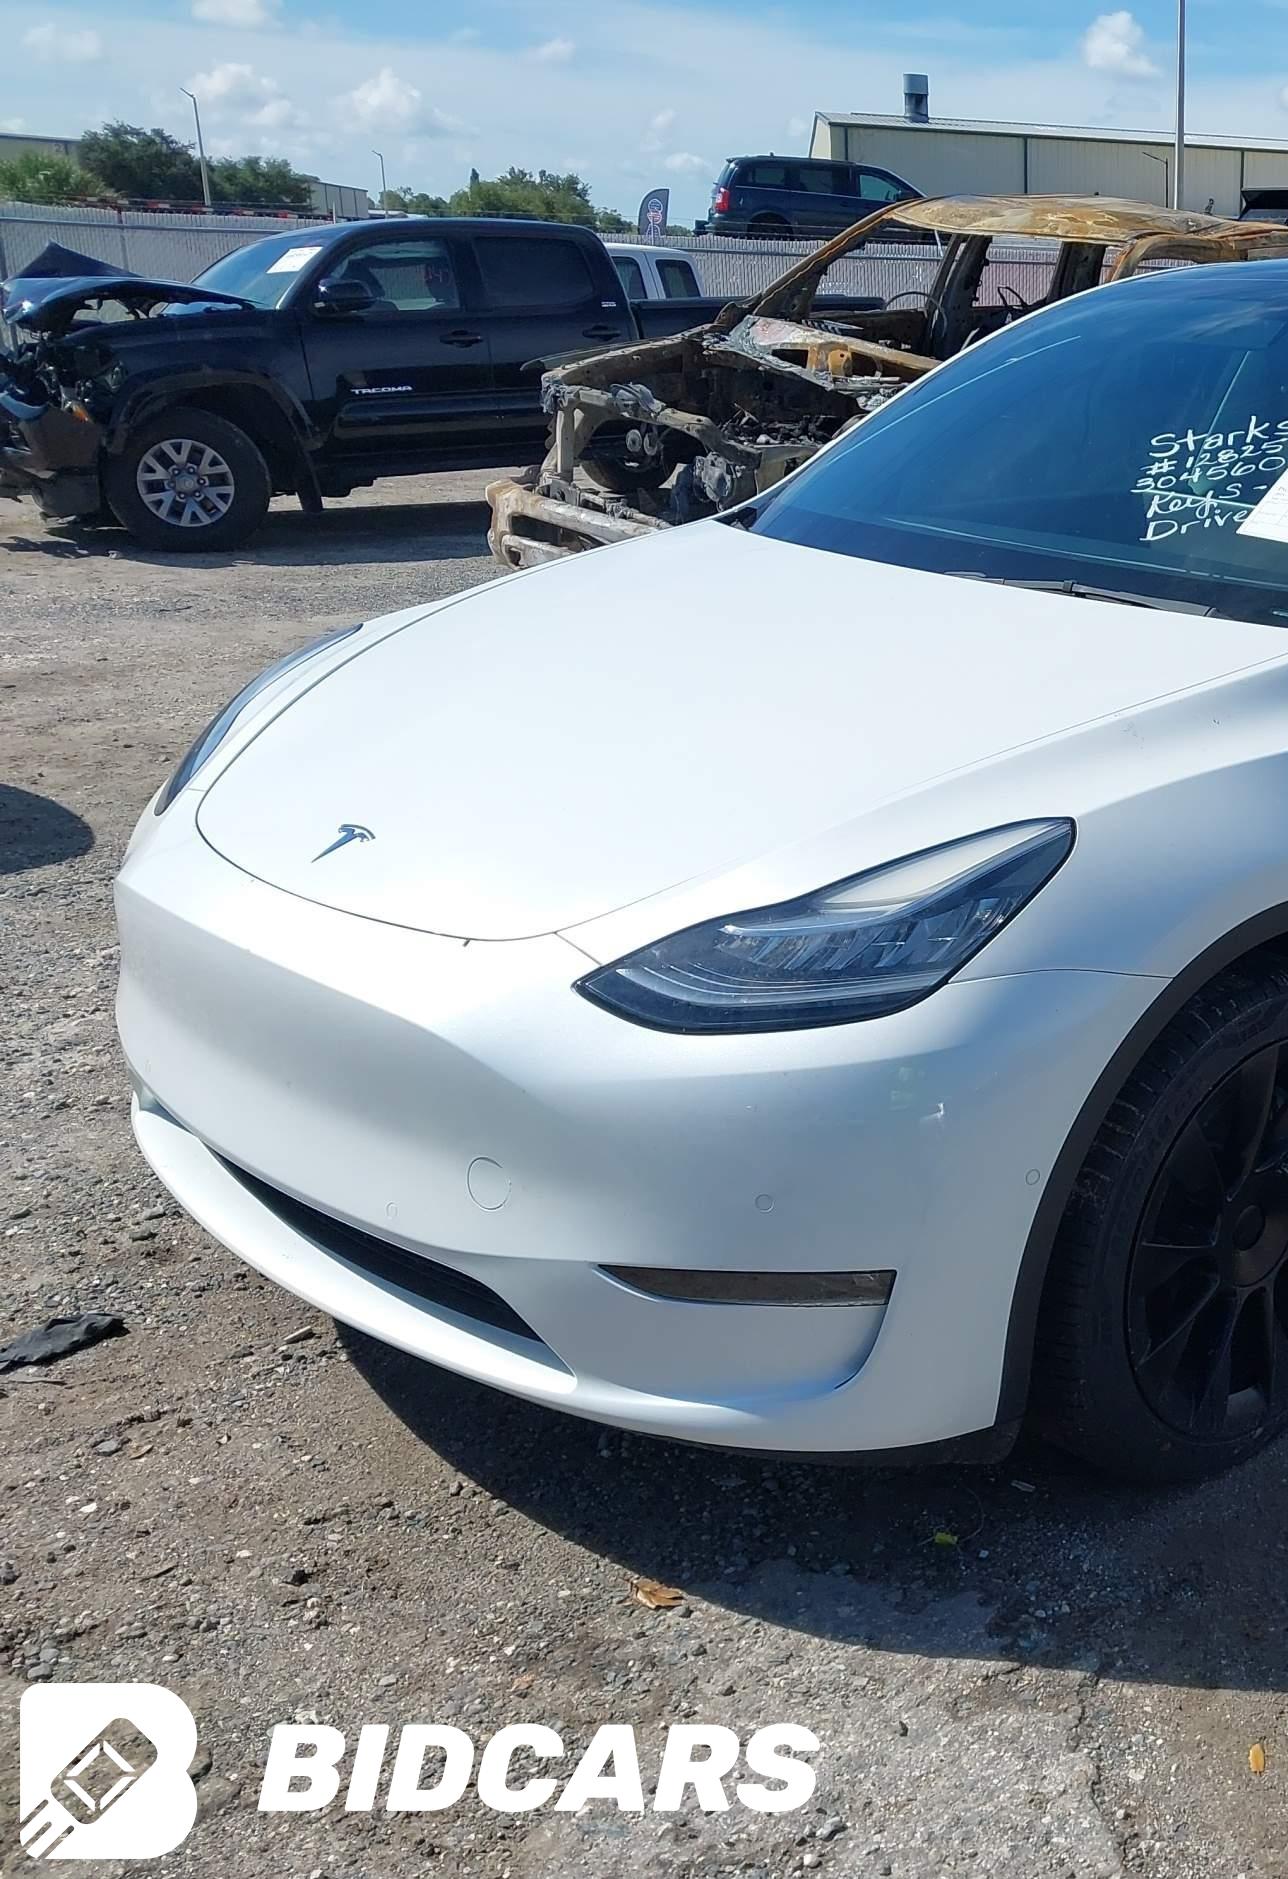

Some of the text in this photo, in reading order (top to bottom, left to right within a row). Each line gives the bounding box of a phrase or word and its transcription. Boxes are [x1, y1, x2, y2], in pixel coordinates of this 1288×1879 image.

[351, 385, 413, 395] TACOMA
[1136, 456, 1286, 491] 304560
[1140, 509, 1248, 540] Drive
